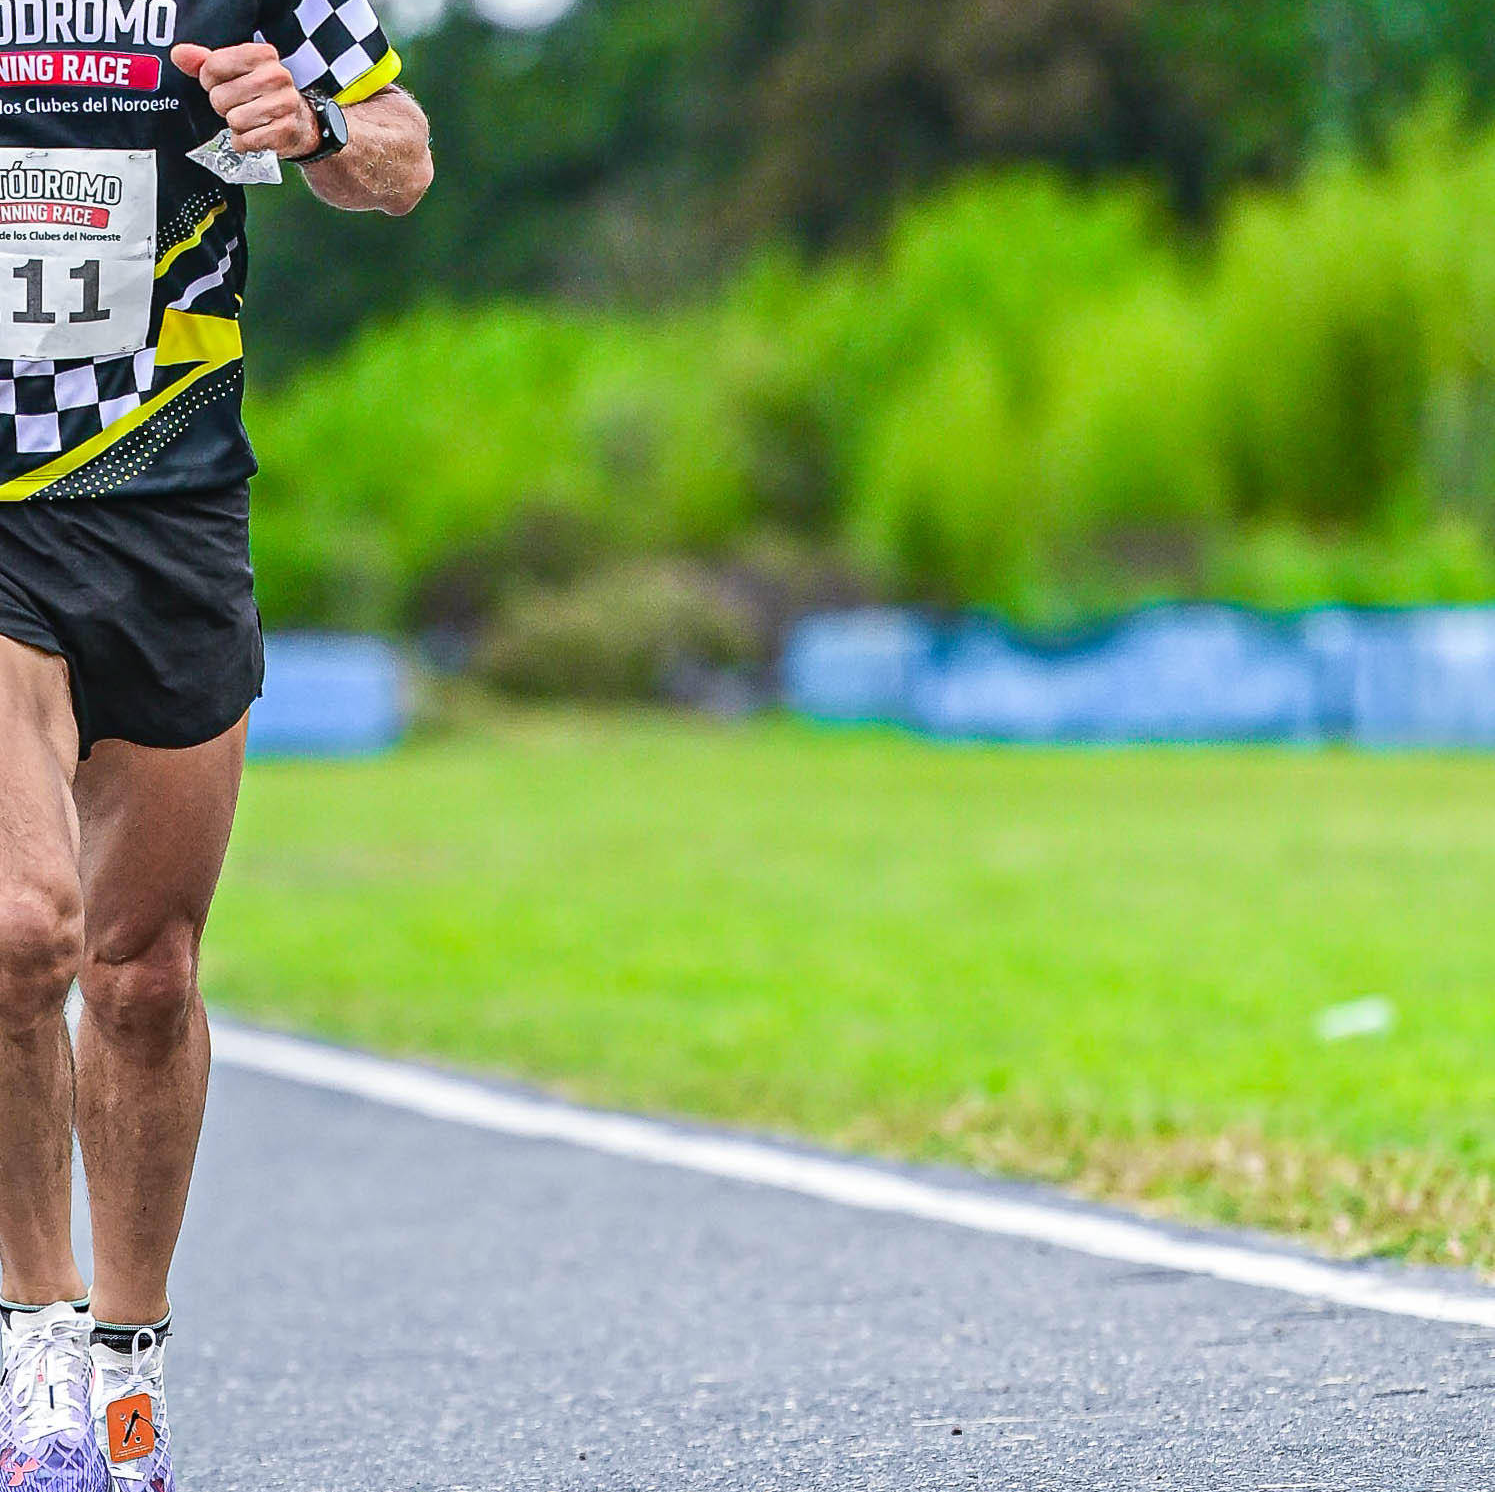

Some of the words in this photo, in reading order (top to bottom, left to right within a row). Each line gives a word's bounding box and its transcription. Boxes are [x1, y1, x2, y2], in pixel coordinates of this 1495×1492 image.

[61, 54, 132, 87] RACE
[25, 97, 79, 113] Clubes
[82, 96, 107, 113] del
[111, 96, 180, 113] Noroeste
[52, 204, 94, 226] RACE
[0, 231, 12, 241] de
[13, 230, 27, 241] los
[29, 231, 61, 241] Clubes
[63, 231, 78, 241] del
[79, 231, 121, 242] Noroeste
